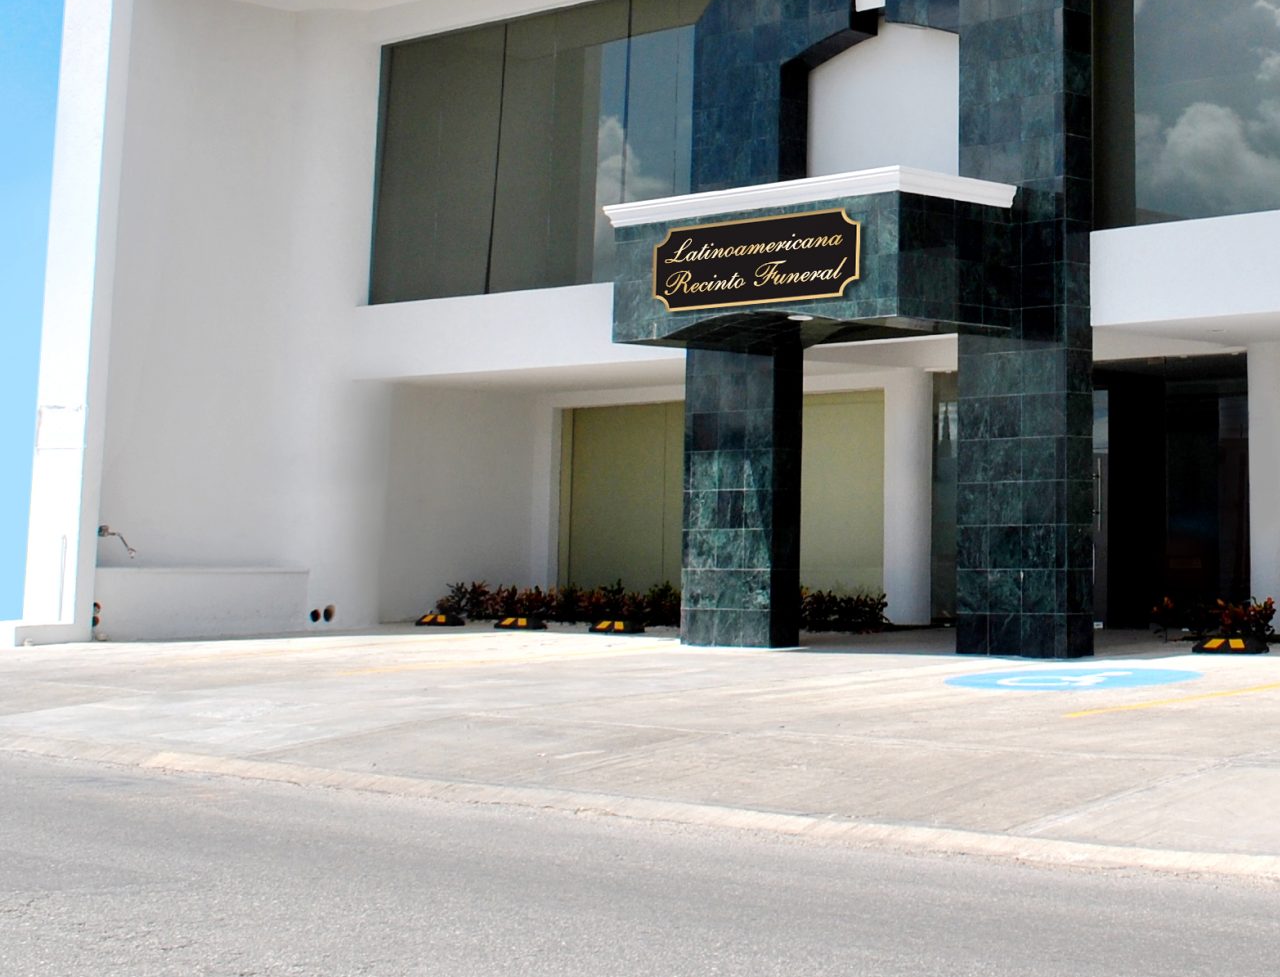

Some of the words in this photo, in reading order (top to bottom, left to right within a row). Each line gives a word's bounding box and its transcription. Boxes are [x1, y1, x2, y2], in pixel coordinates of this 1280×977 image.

[664, 233, 843, 264] Latinoamericana
[664, 269, 746, 297] Recinto
[753, 257, 848, 287] Funeral
